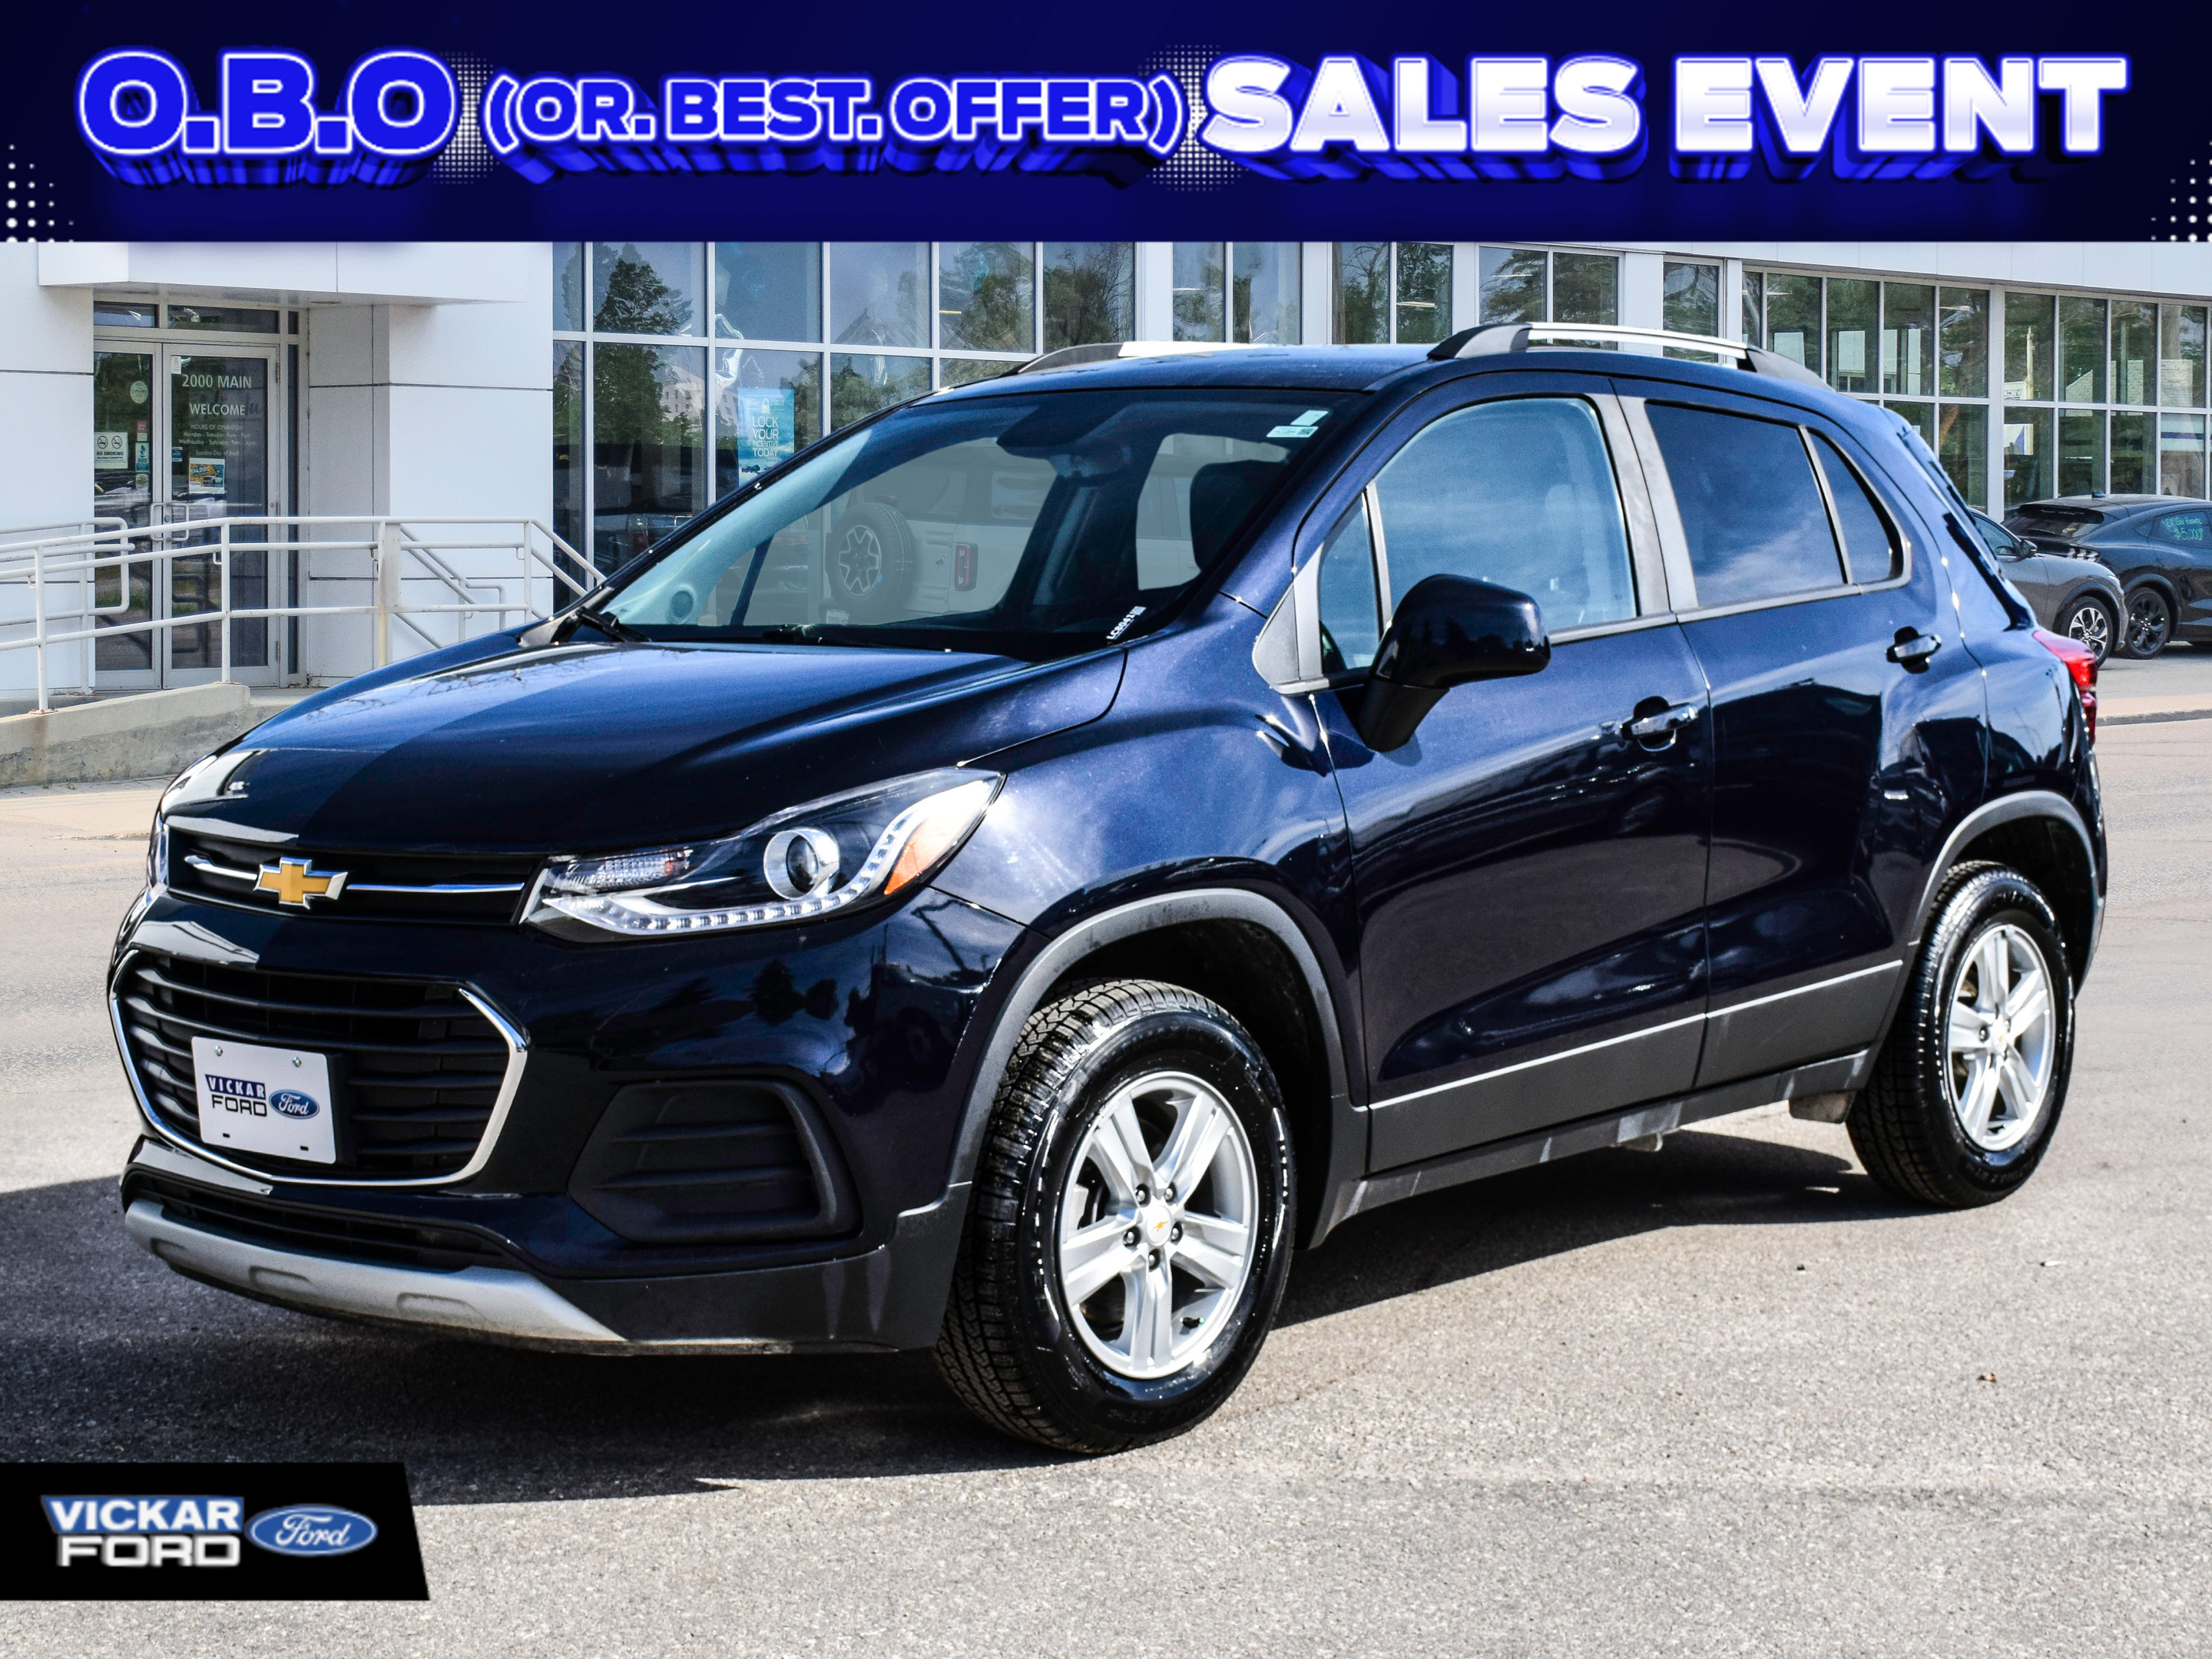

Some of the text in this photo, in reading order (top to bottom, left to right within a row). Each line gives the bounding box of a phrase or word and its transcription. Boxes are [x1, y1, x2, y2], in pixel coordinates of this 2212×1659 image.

[182, 374, 253, 389] 2000 MAIN
[189, 402, 246, 416] WELCOME
[752, 416, 779, 428] LOCK
[752, 428, 780, 440] YOUR
[753, 447, 779, 457] TODAY
[208, 1075, 265, 1099] VICKAR
[211, 1094, 267, 1118] FORD
[278, 1093, 310, 1115] Ford
